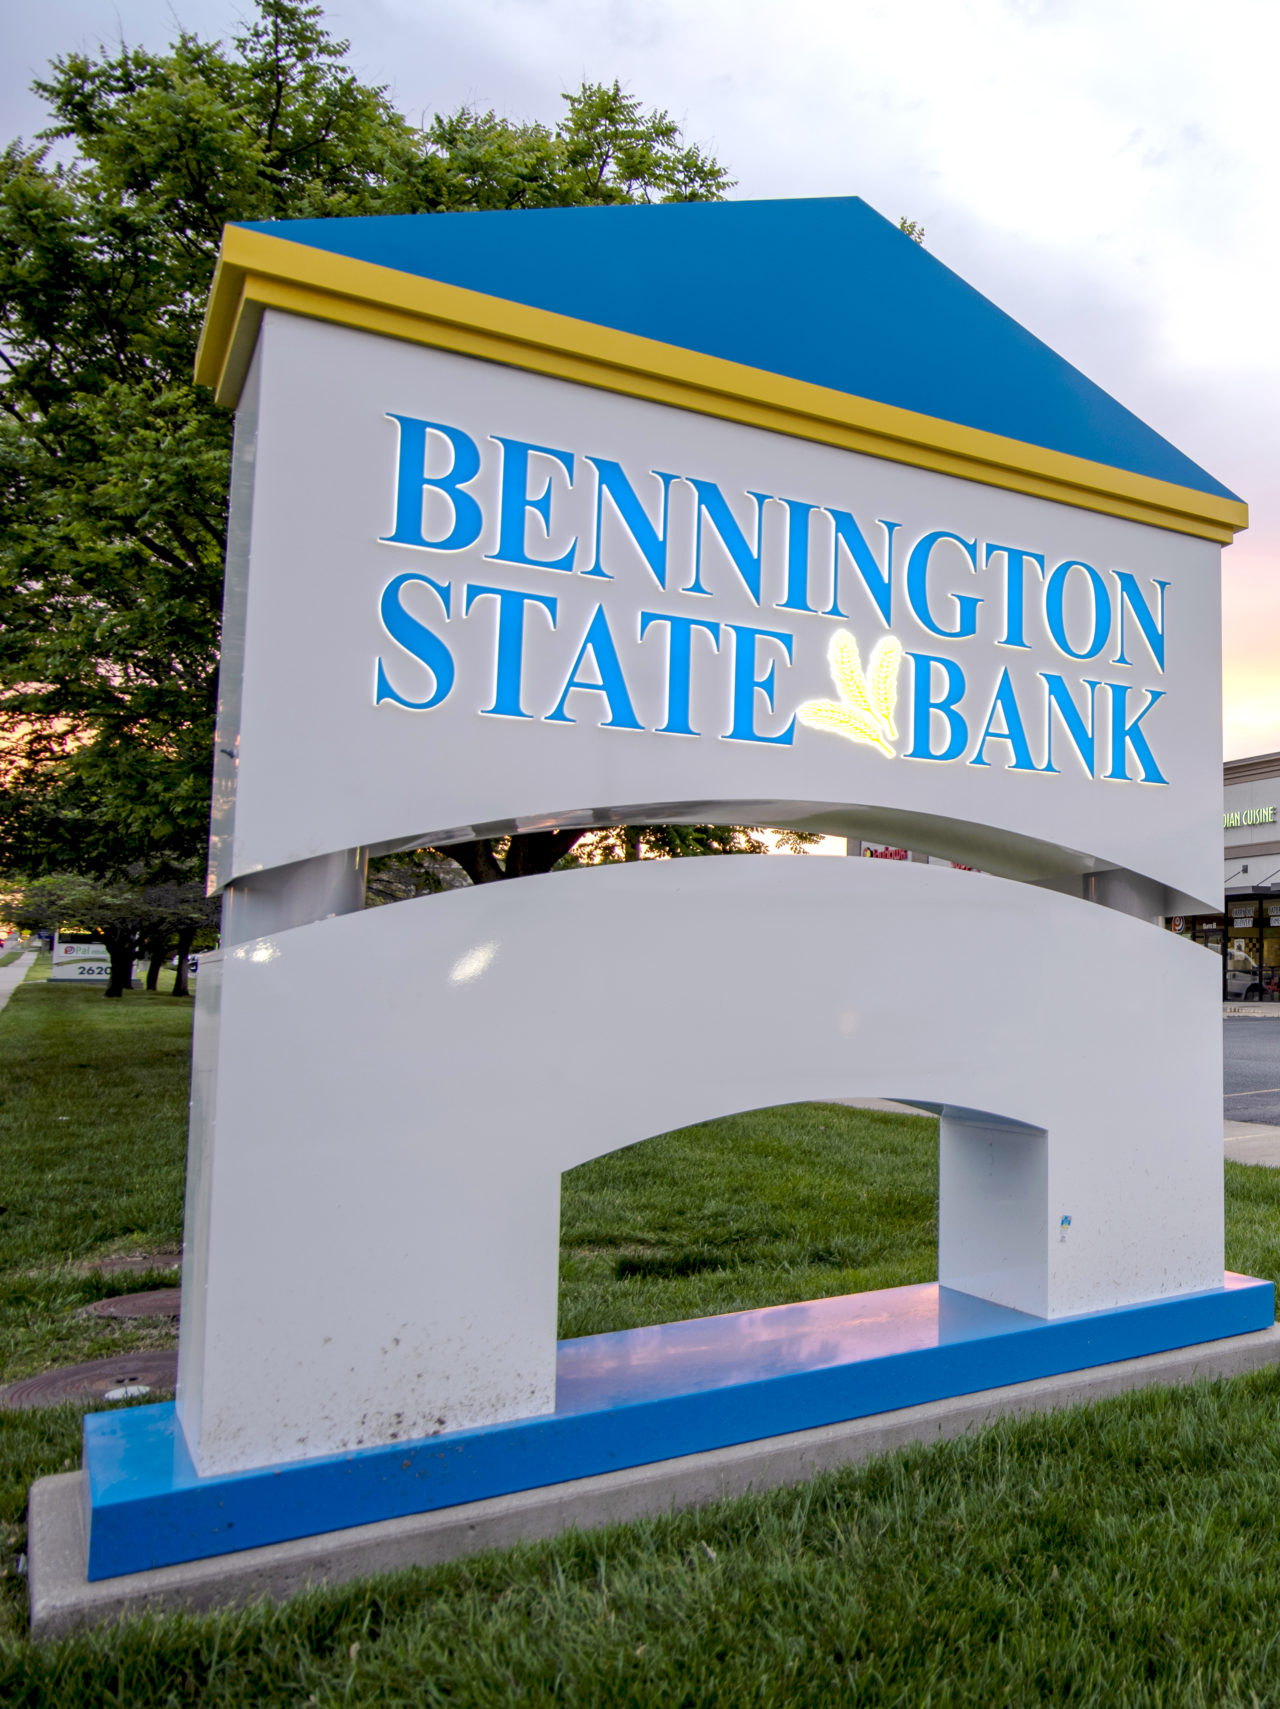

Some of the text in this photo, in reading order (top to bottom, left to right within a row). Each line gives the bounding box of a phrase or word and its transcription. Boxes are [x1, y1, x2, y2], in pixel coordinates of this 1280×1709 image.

[378, 412, 1171, 674] BENNINGTON
[375, 572, 1170, 786] STATE BANK
[1242, 806, 1275, 825] CUISINE
